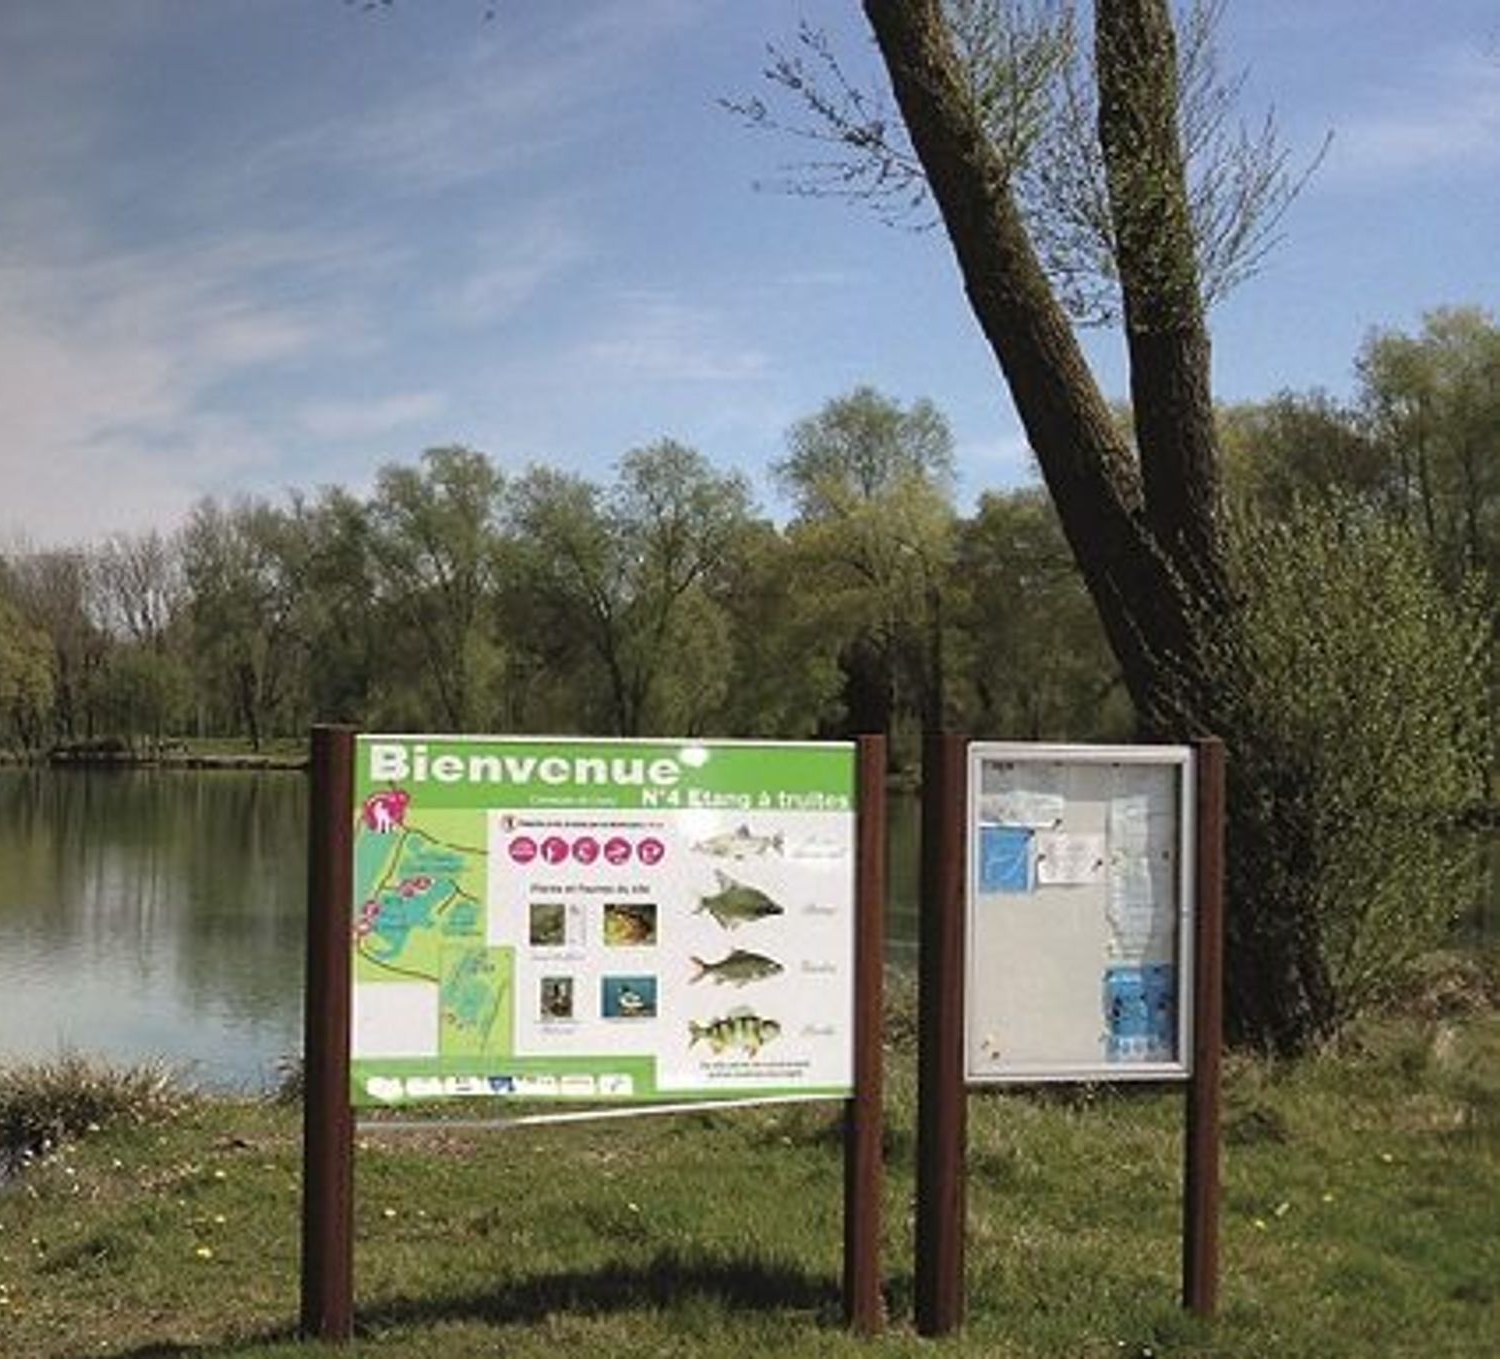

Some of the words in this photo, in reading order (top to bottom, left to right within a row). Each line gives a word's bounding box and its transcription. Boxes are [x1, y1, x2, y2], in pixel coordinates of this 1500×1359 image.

[369, 744, 682, 786] Bienvenue
[641, 788, 679, 807] N°4
[687, 789, 750, 810] Etang
[757, 790, 772, 807] à
[779, 791, 849, 808] truites
